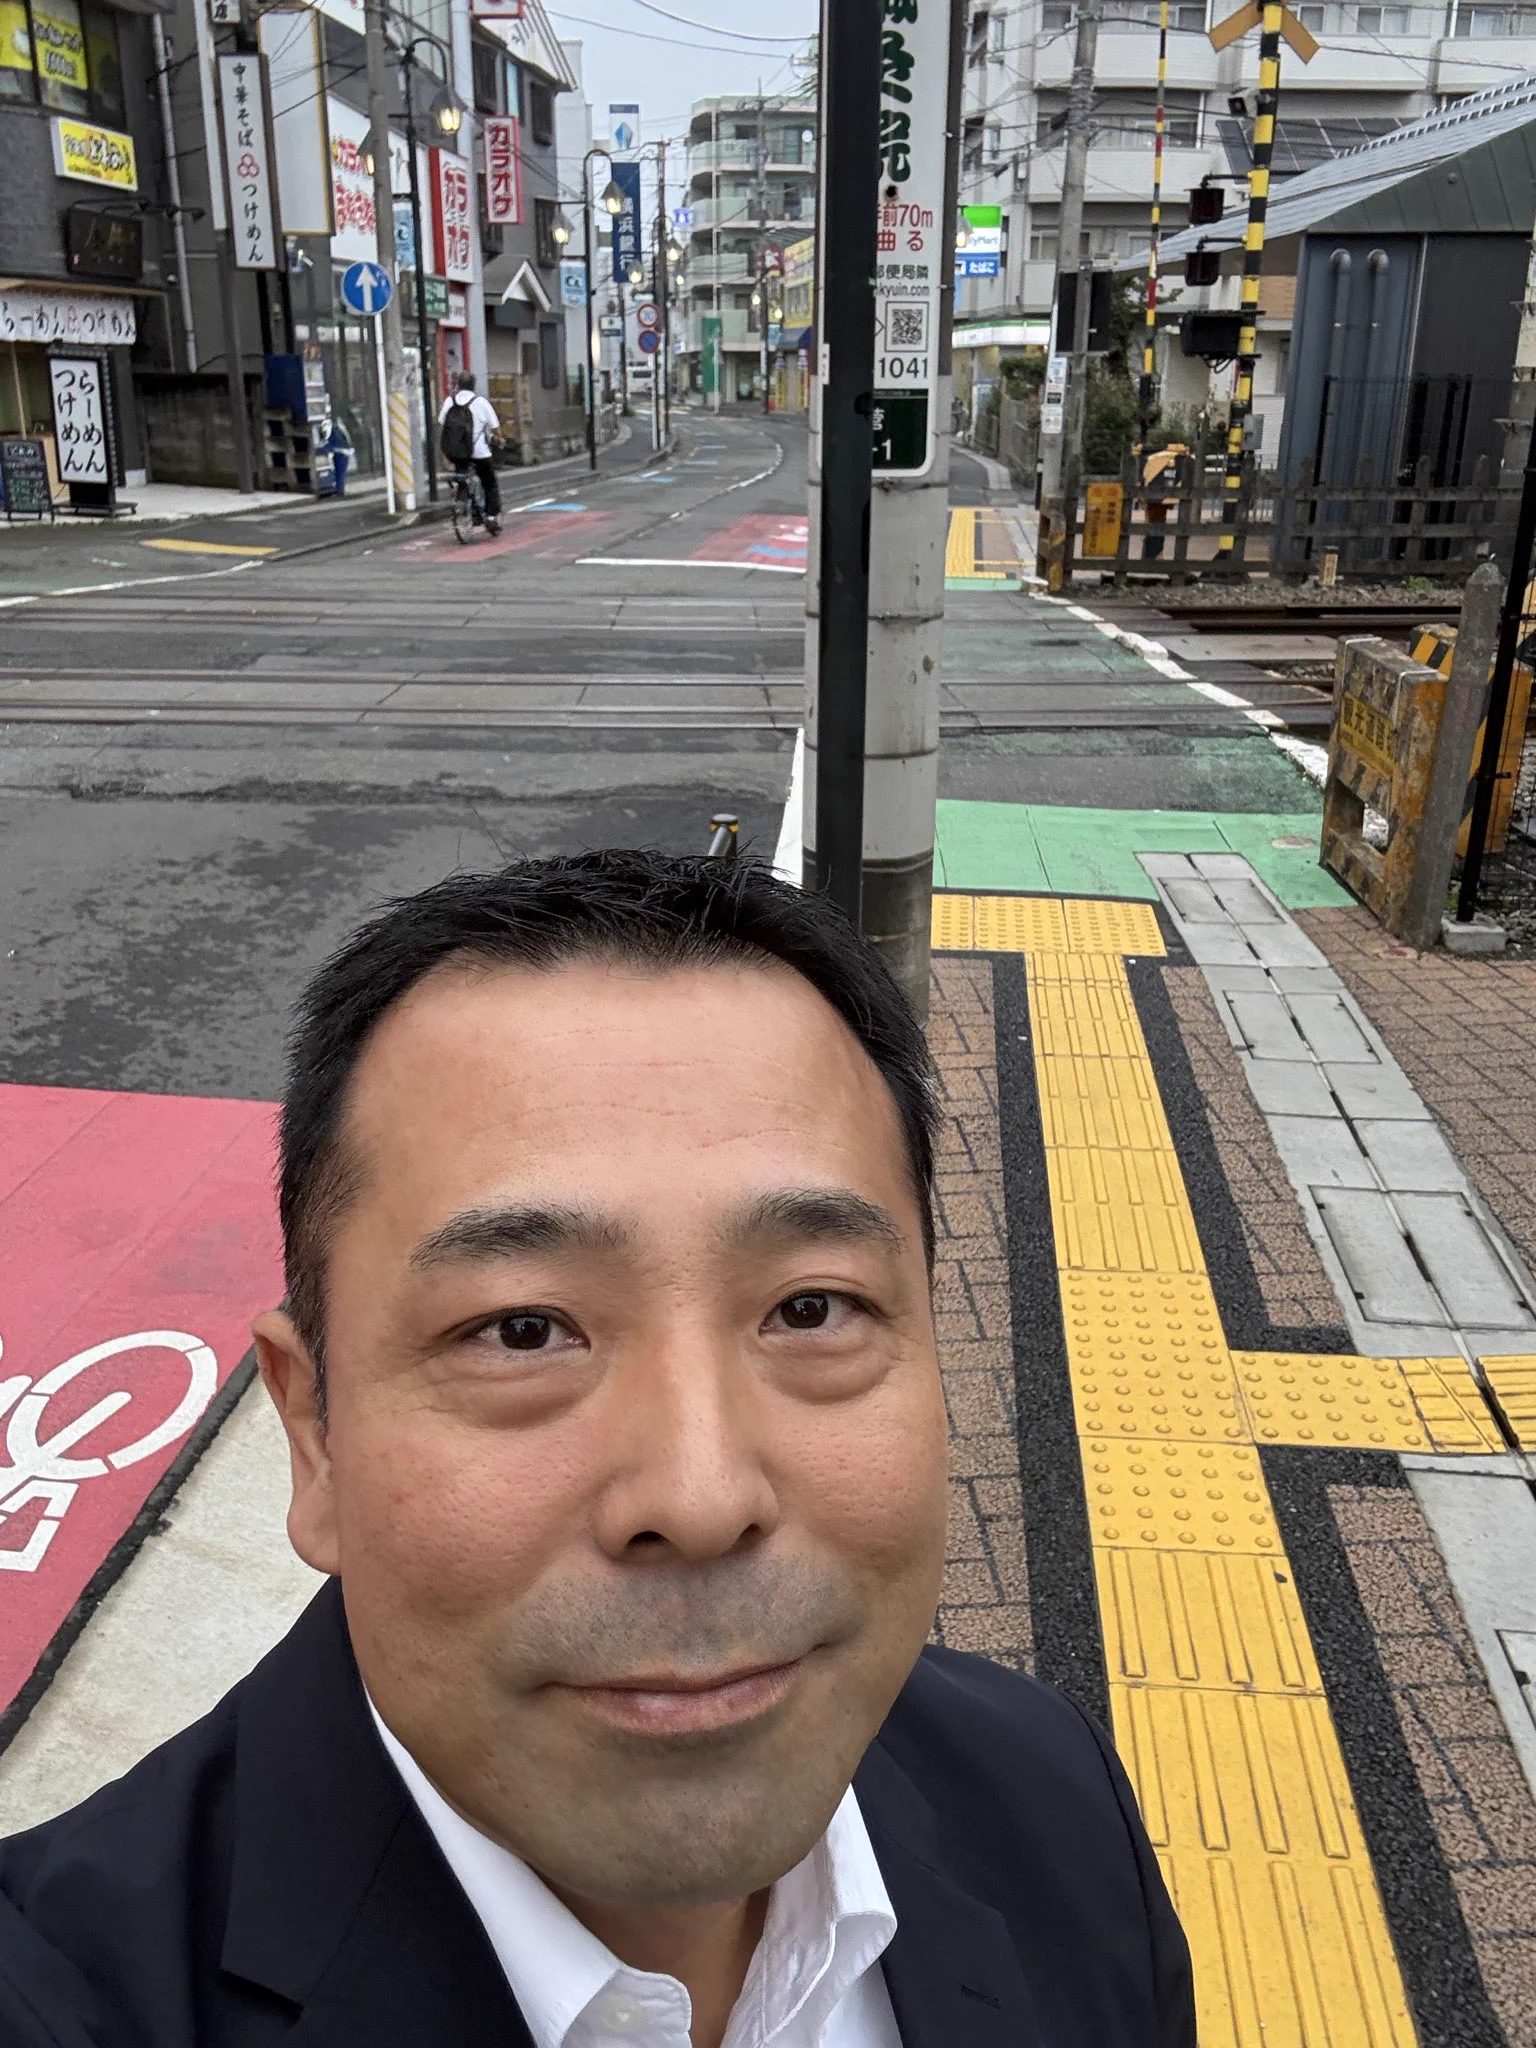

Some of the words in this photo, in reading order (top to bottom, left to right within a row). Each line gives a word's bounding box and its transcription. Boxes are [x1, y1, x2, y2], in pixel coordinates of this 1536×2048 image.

[232, 62, 254, 149] 中華そば
[490, 125, 511, 216] カラオケ
[242, 183, 264, 263] つけめん
[968, 261, 995, 274] たばこ
[878, 358, 929, 379] 1041
[54, 369, 84, 473] つけめん
[78, 372, 105, 474] らーめん
